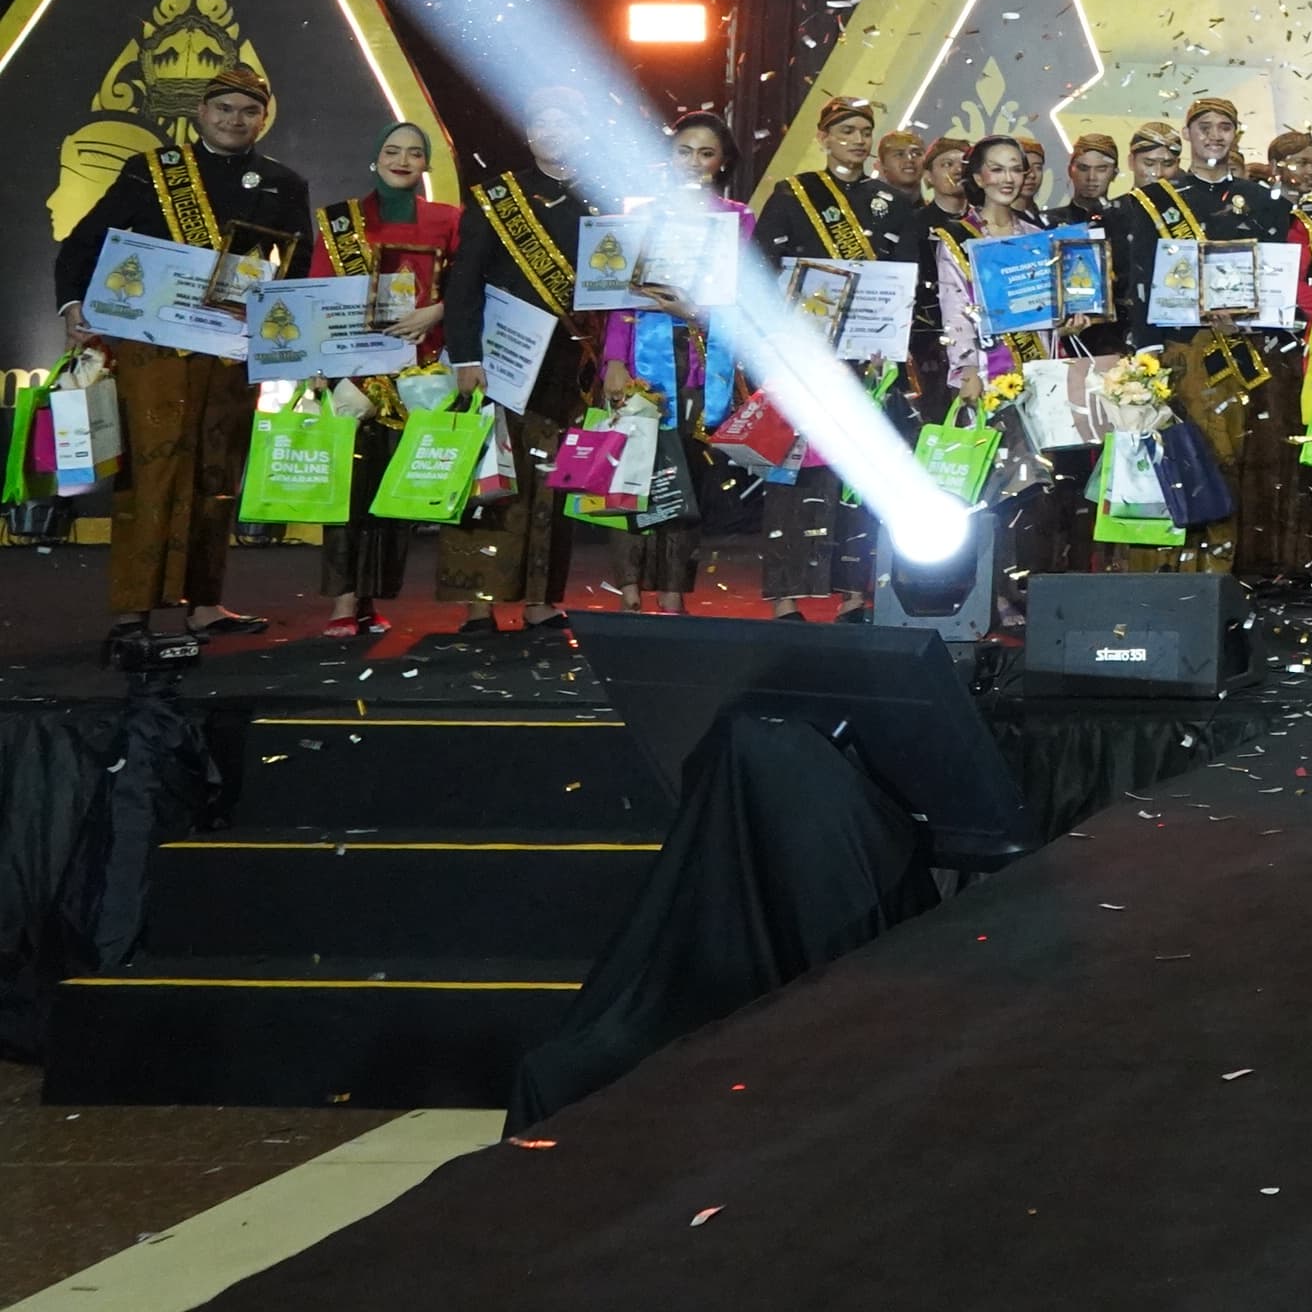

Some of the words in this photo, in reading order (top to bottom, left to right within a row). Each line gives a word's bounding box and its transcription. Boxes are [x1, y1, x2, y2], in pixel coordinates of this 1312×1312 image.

[507, 211, 531, 241] BEST
[271, 447, 331, 462] BINUS
[414, 447, 459, 460] BINUS
[271, 462, 330, 475] ONLINE
[411, 459, 455, 471] ONLINE
